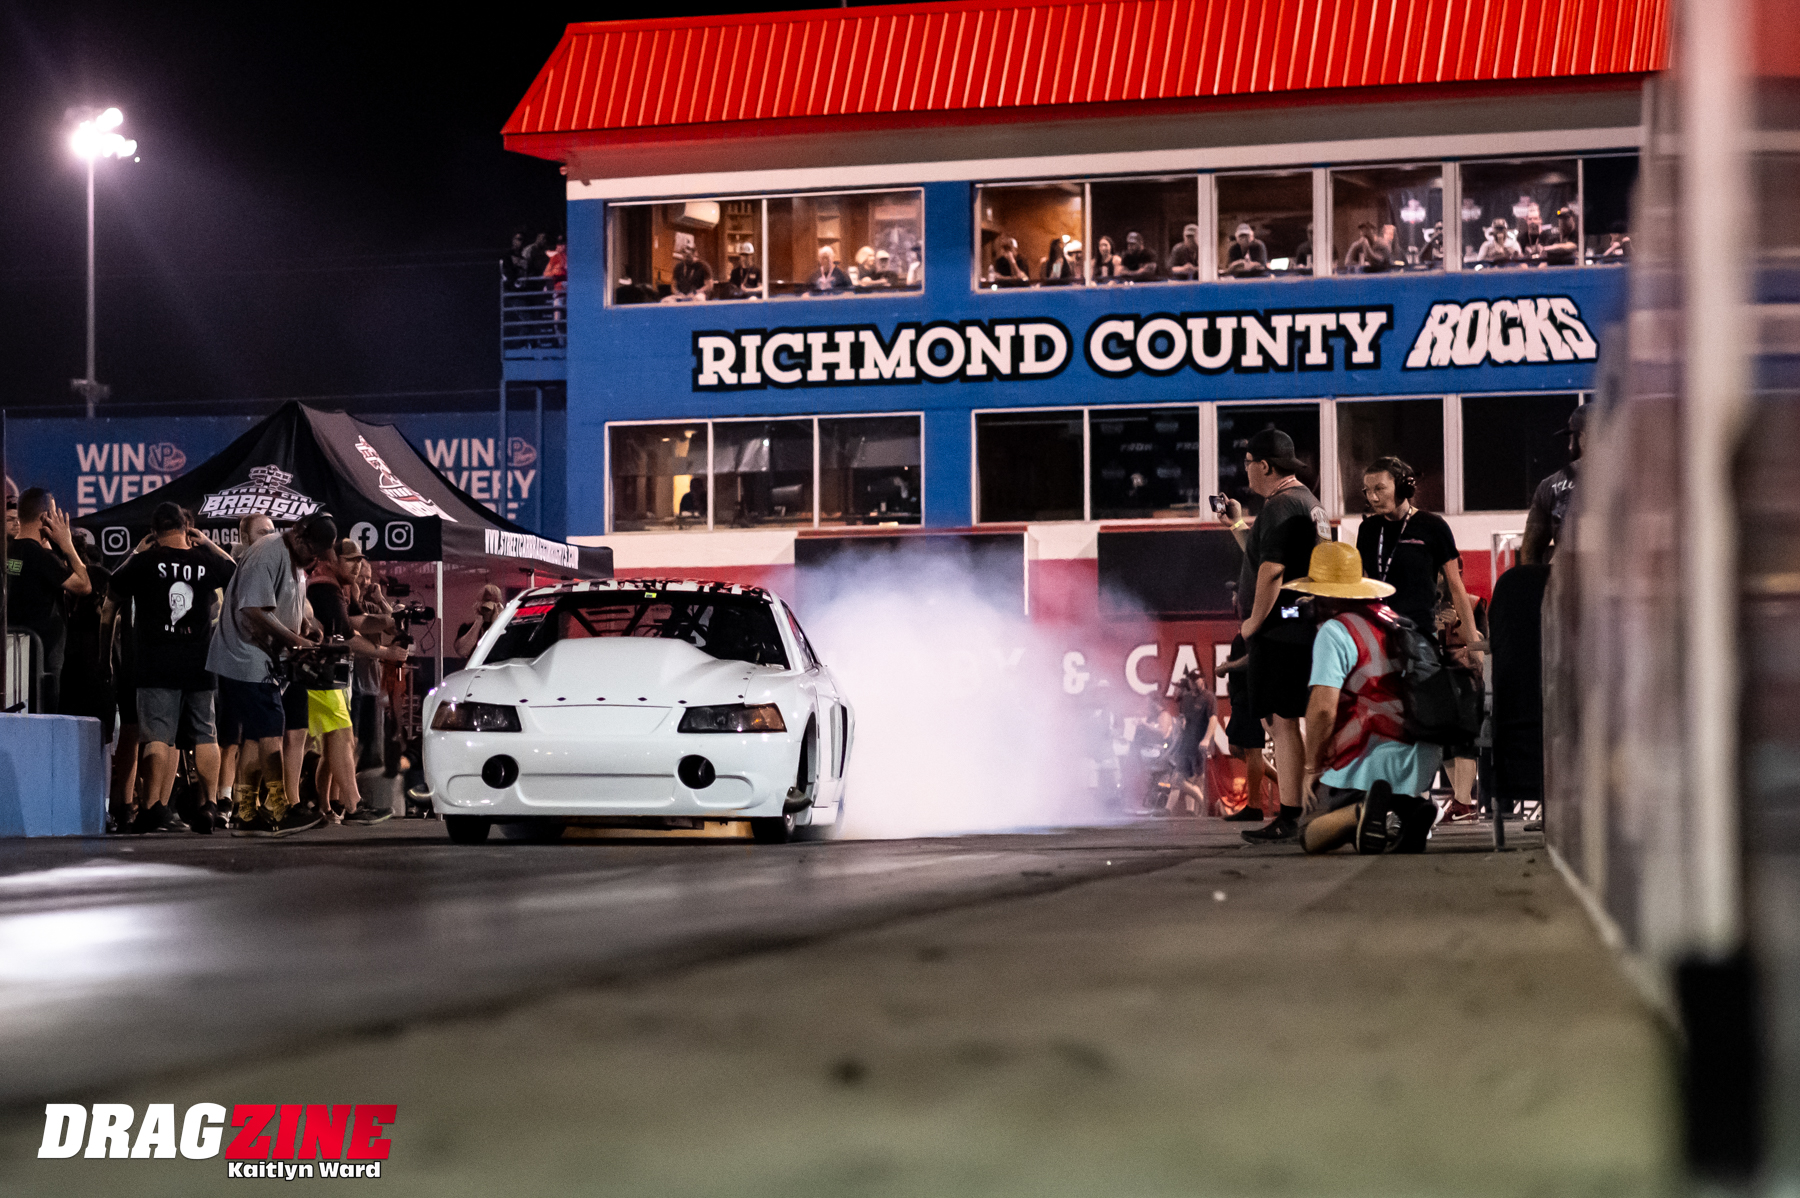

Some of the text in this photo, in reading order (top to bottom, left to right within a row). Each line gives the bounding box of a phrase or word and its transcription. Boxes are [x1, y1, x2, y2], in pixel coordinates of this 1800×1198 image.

[698, 297, 1598, 387] RICHMOND COUNTY ROCKS
[76, 443, 145, 472] WIN
[424, 437, 495, 468] WIN
[203, 494, 318, 516] BRAGGIN
[210, 507, 299, 520] RIGHTS
[157, 562, 206, 581] STOP
